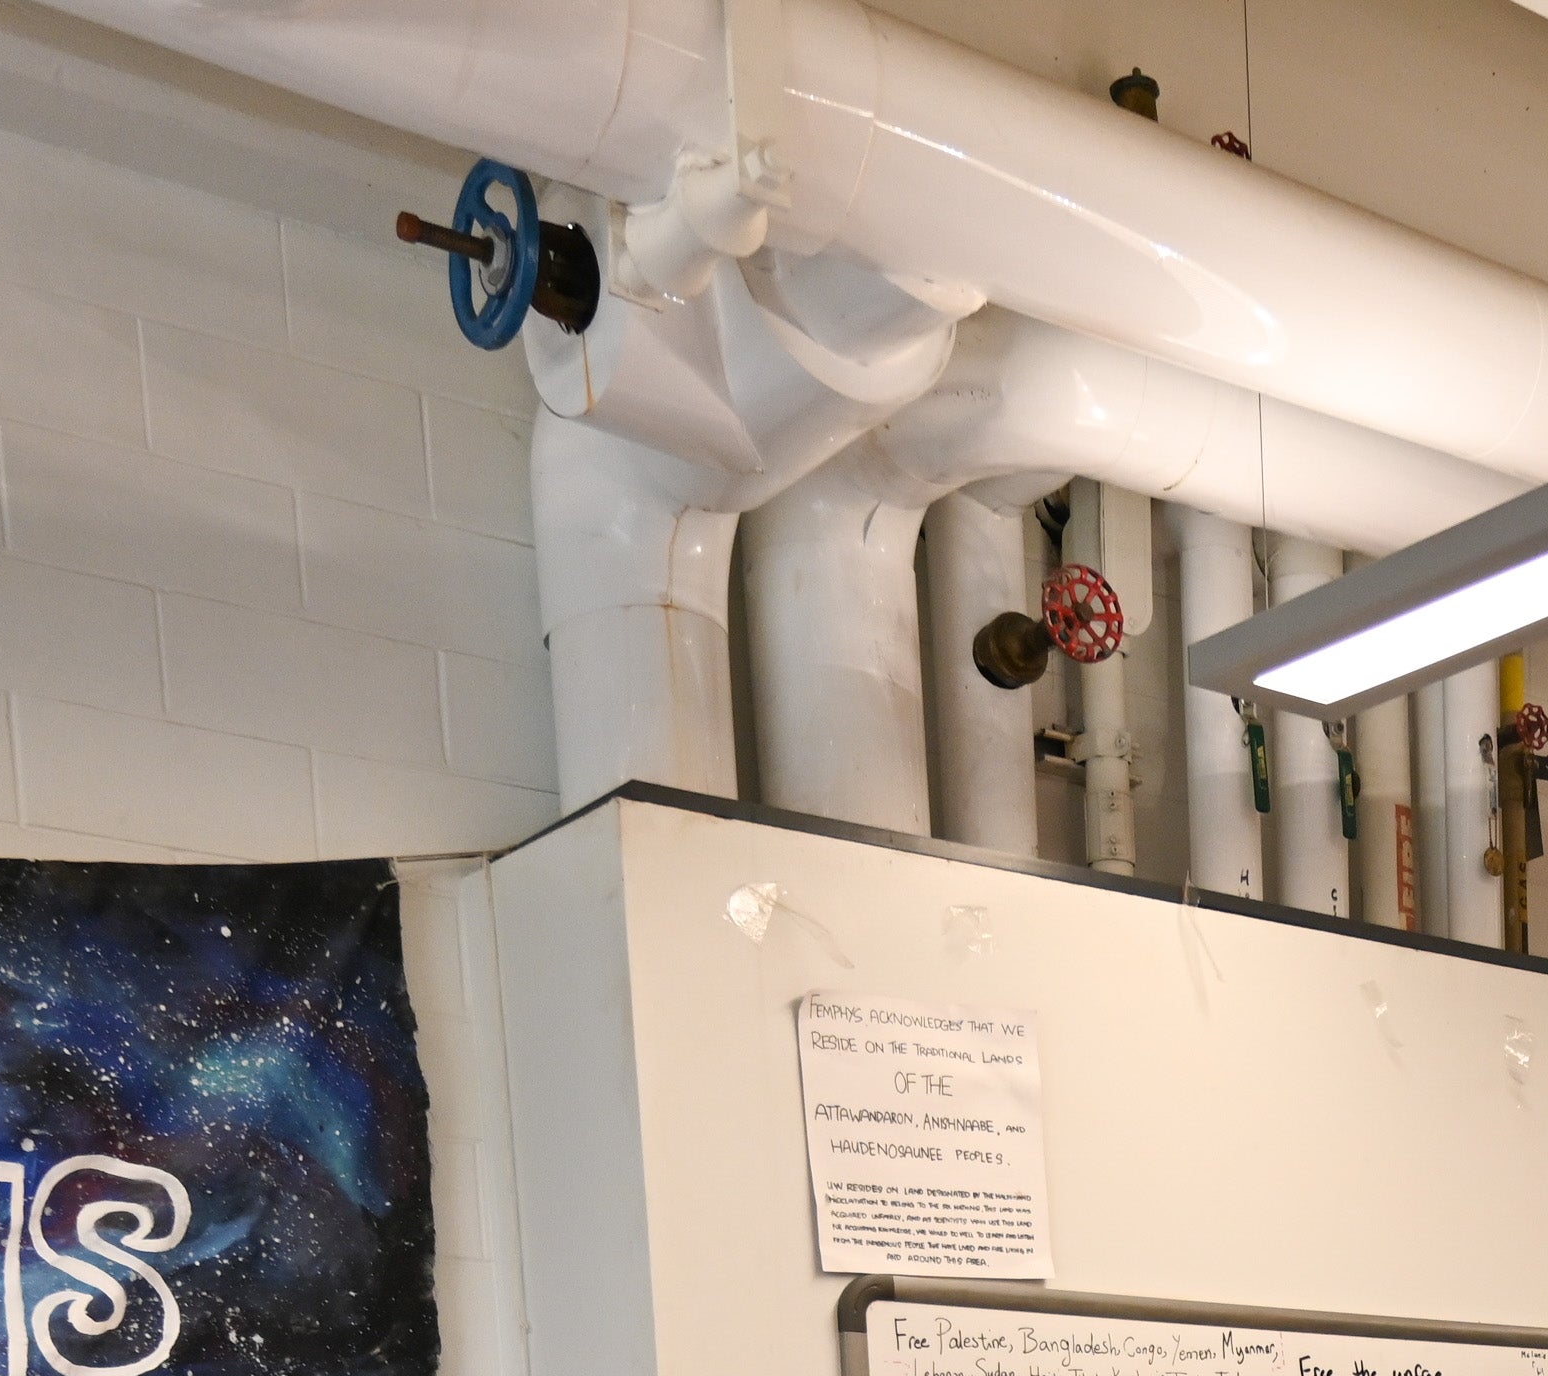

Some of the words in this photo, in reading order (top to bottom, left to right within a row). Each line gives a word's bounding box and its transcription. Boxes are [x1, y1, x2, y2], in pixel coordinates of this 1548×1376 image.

[968, 1020, 993, 1034] THAT
[1001, 1023, 1025, 1037] WE
[865, 1041, 884, 1054] ON
[888, 1041, 907, 1055] THE
[894, 1071, 916, 1094] OF
[921, 1074, 954, 1097] THE
[1005, 1125, 1026, 1135] AND
[894, 1317, 930, 1351] Free
[935, 1317, 1013, 1355] Palestine,
[1018, 1327, 1121, 1367] Bangladesh,
[1172, 1335, 1217, 1365] Yemen,
